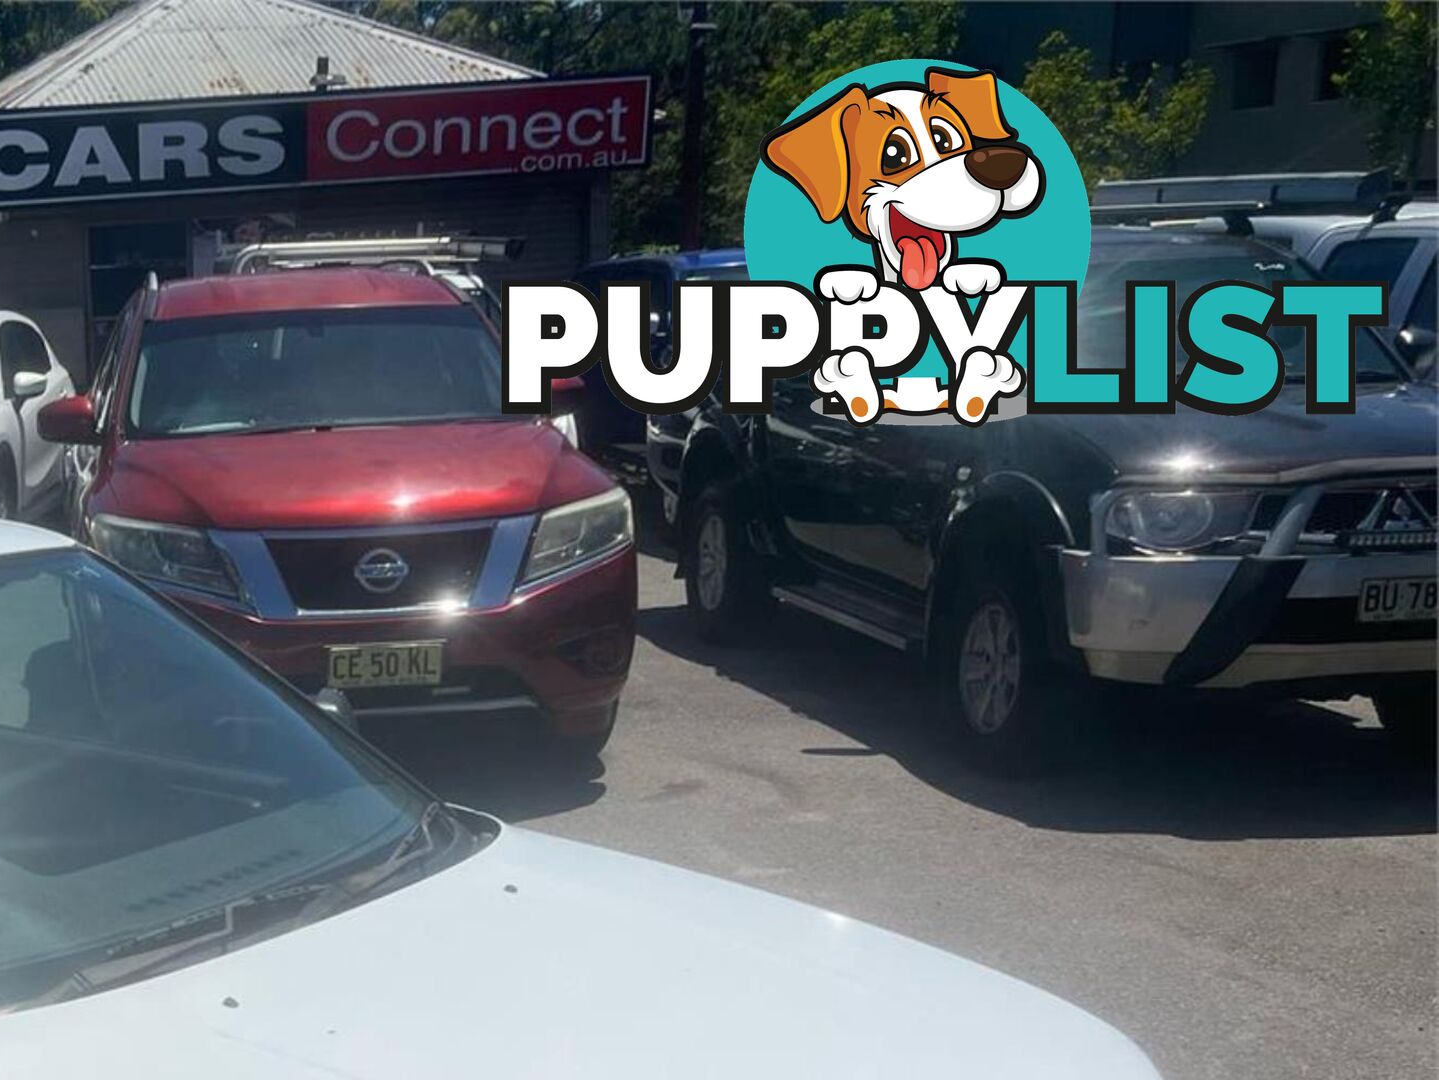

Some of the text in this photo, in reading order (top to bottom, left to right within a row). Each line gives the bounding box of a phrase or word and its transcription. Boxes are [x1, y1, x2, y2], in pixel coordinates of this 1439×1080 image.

[326, 97, 628, 162] Connect
[333, 647, 437, 679] CE 50 KL
